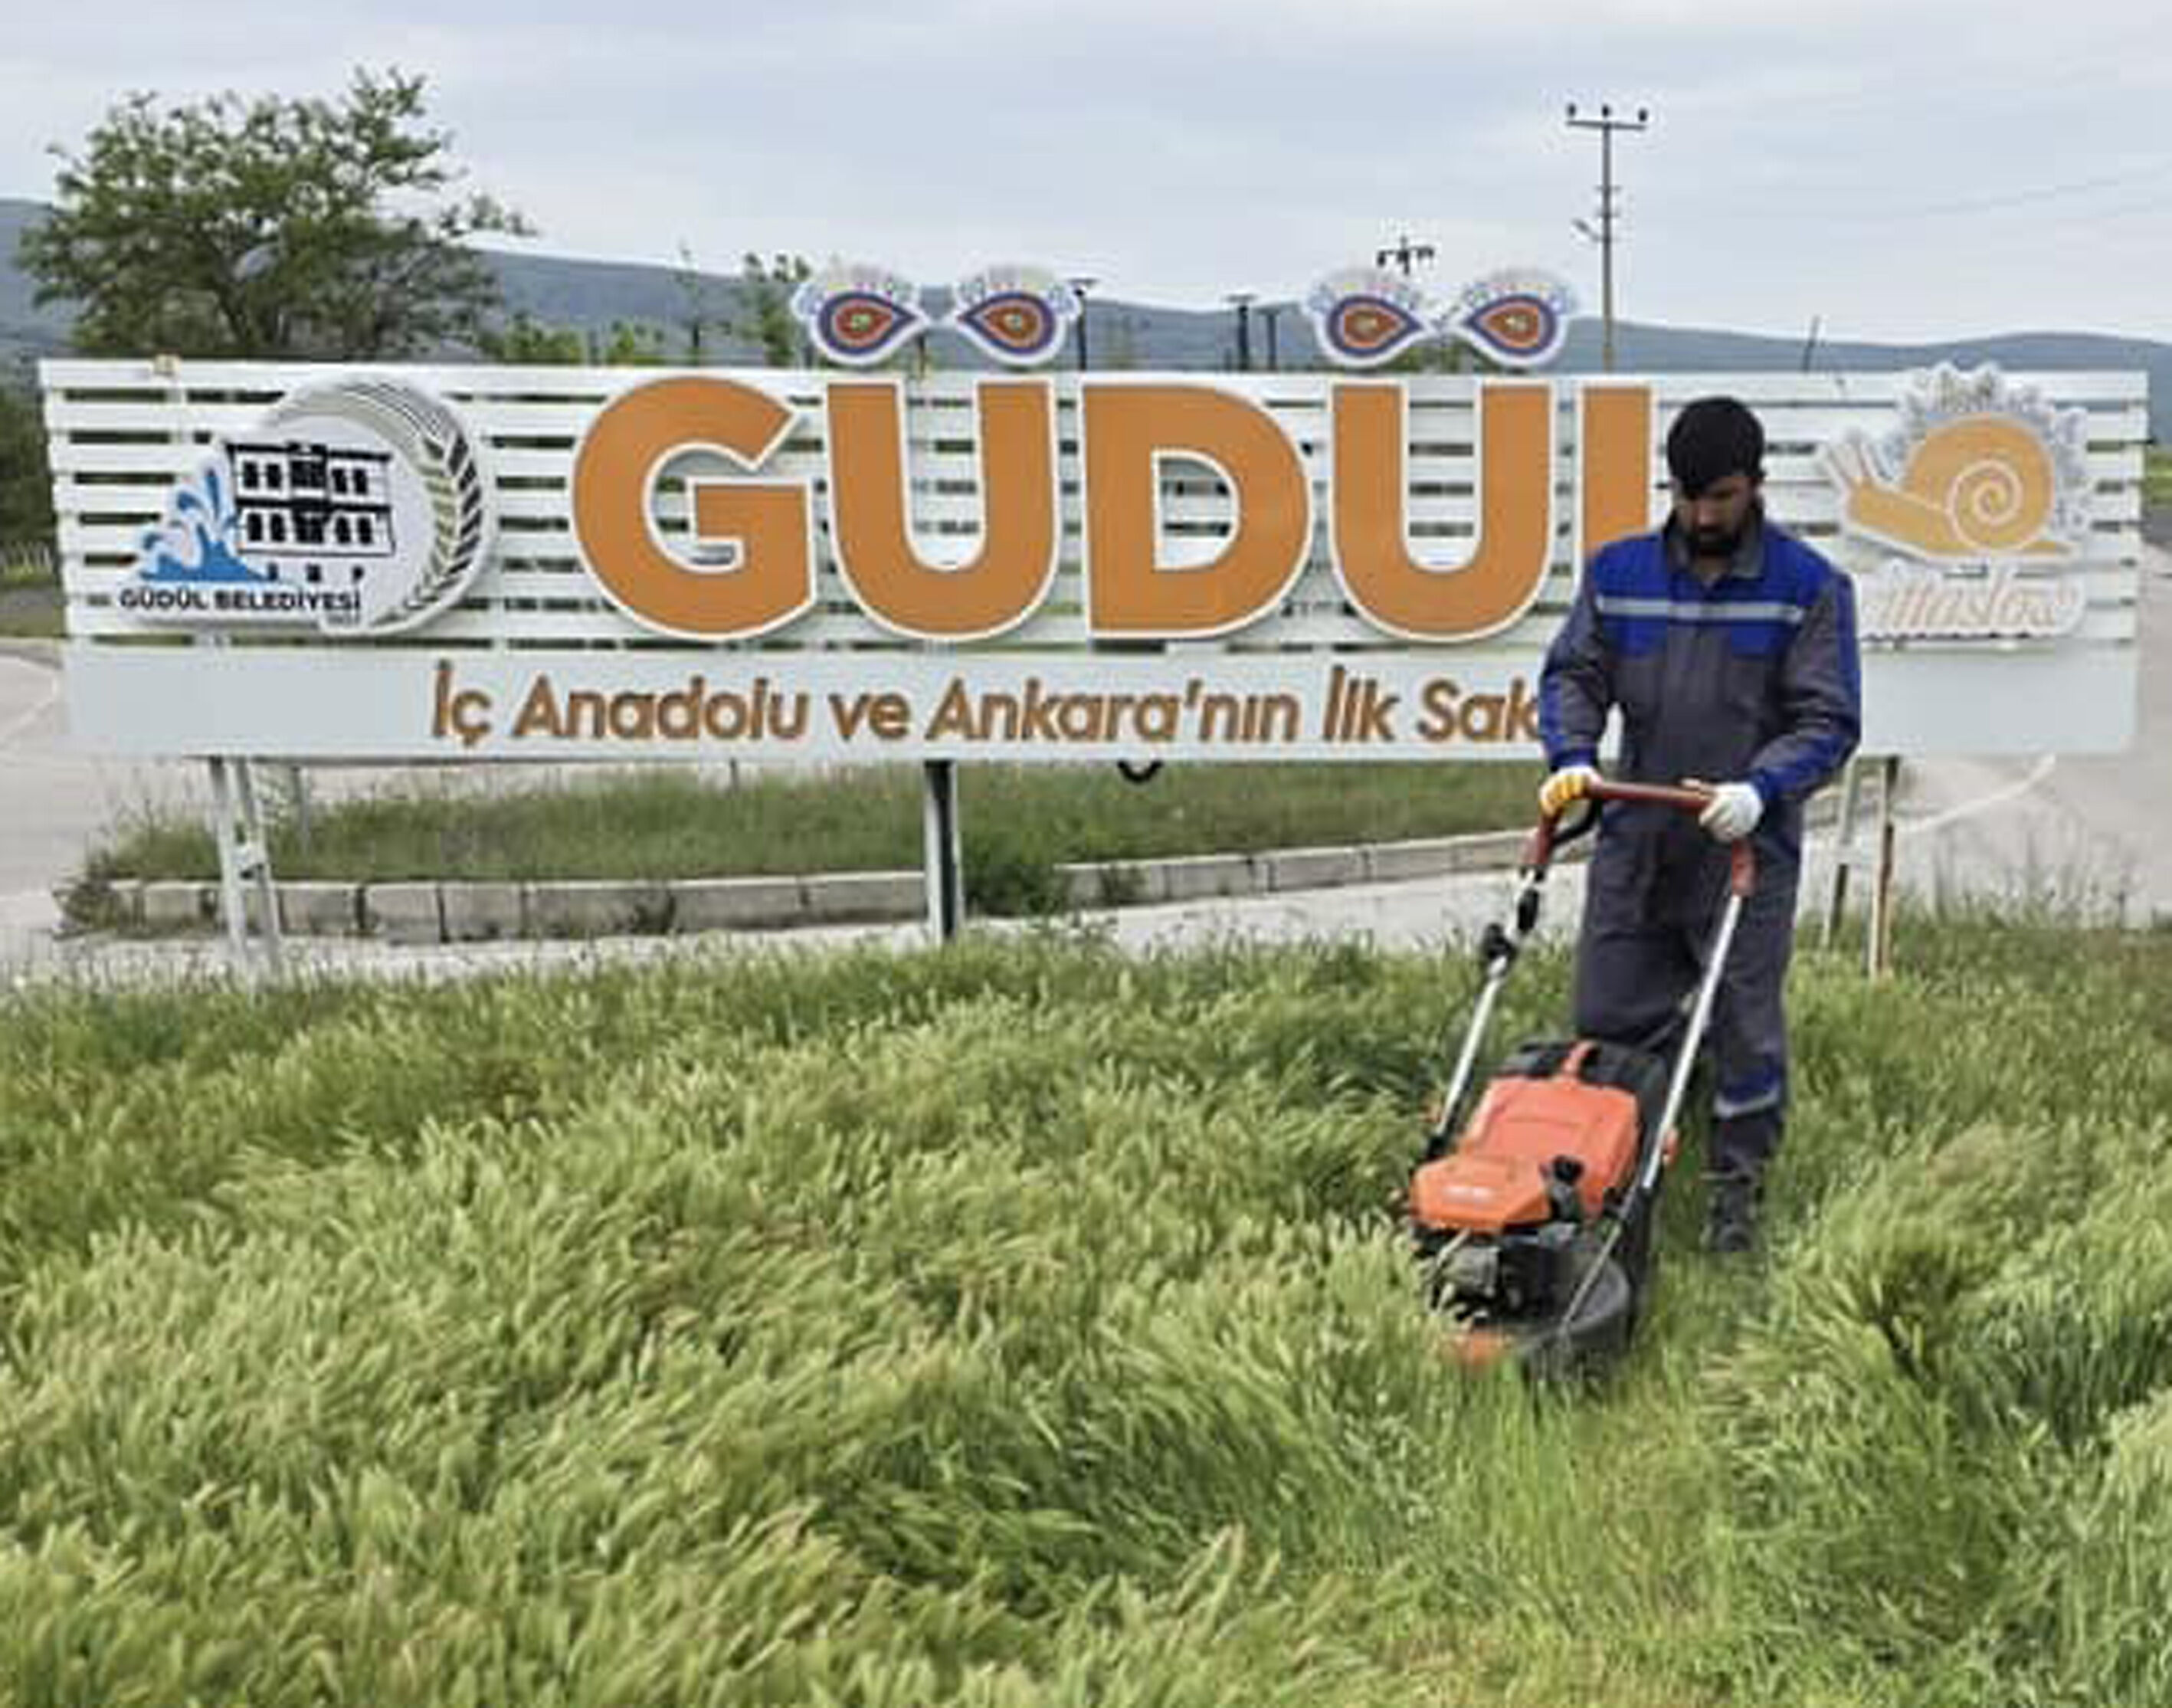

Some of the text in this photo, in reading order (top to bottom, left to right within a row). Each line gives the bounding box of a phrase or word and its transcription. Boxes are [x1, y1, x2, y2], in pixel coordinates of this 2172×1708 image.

[120, 585, 361, 611] GÜDÜL BELEDİYESİ
[432, 663, 492, 747] İç
[512, 674, 809, 739] Anadolu
[828, 693, 910, 739] ve
[925, 678, 1299, 741] Ankara'nın
[1322, 664, 1400, 741] İlk
